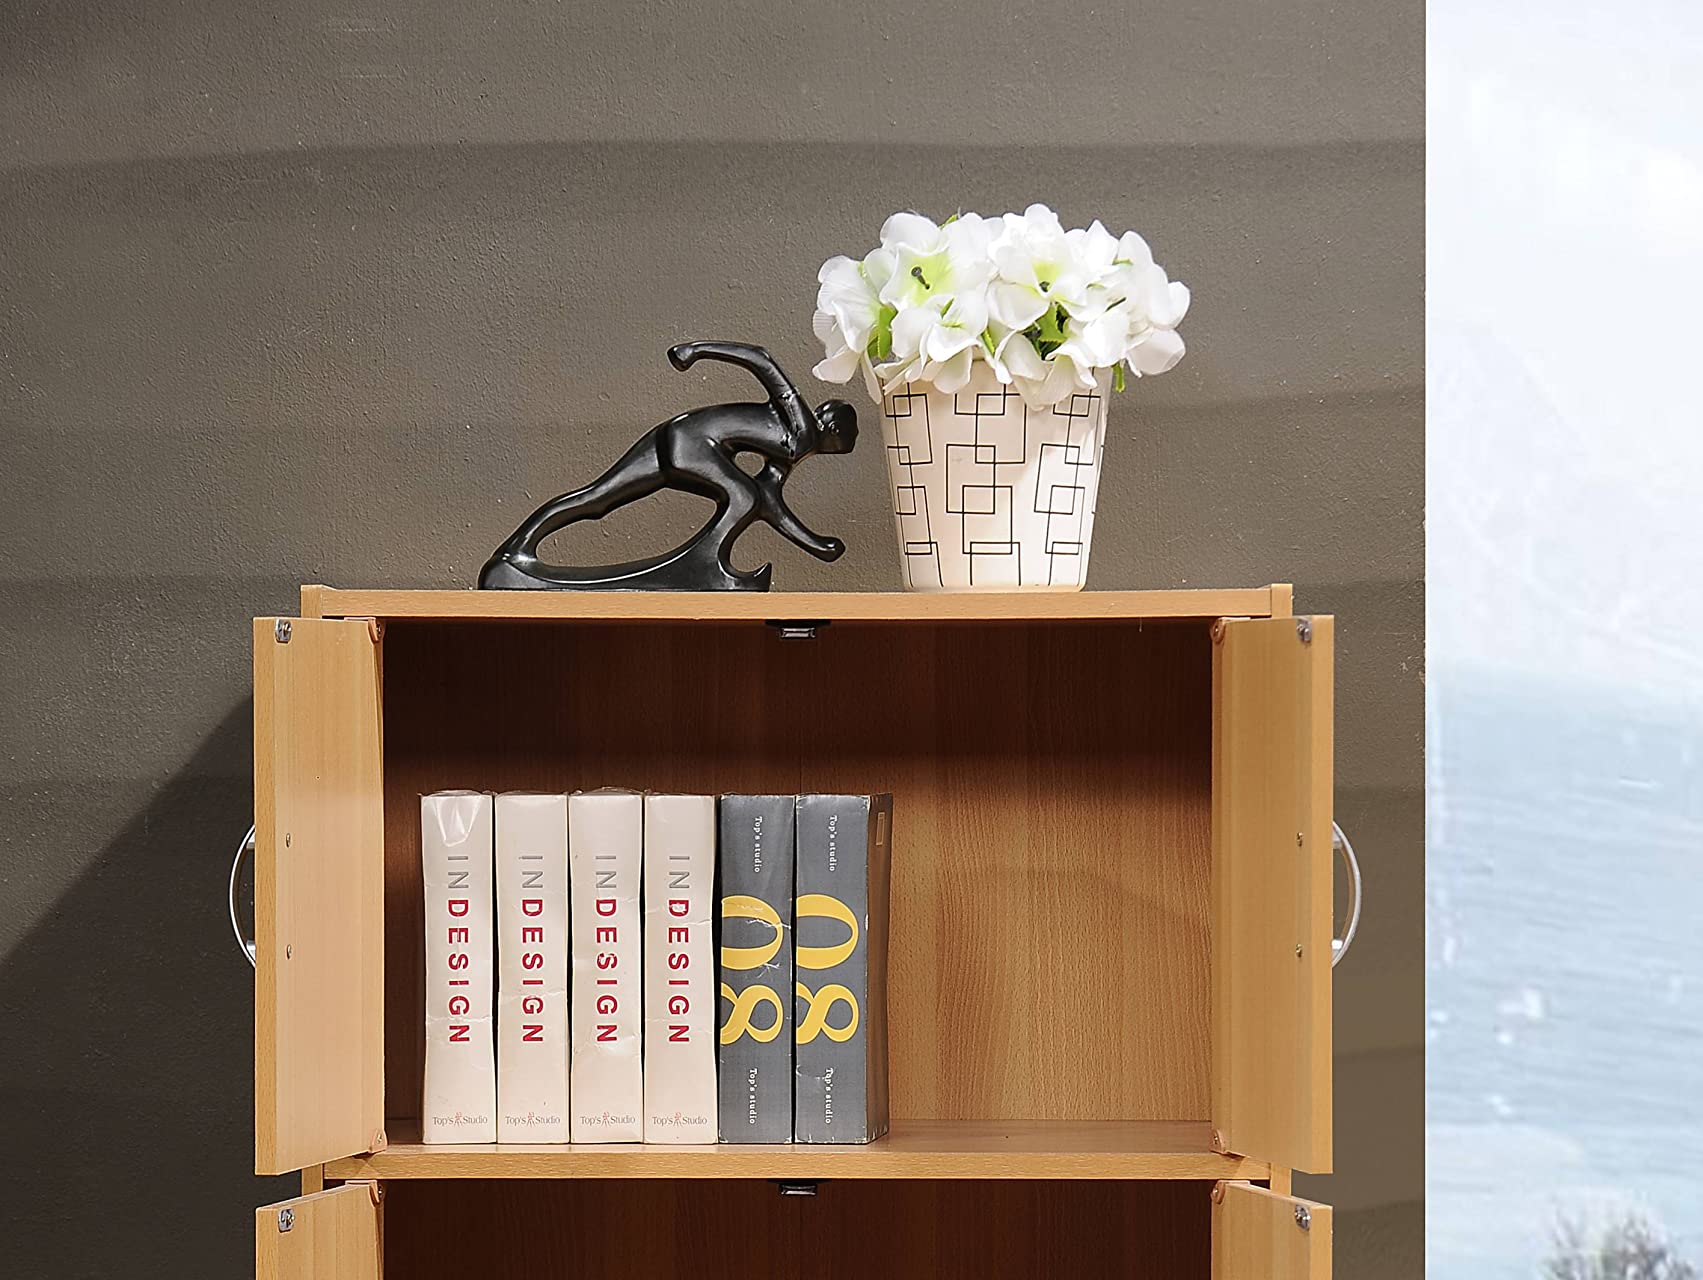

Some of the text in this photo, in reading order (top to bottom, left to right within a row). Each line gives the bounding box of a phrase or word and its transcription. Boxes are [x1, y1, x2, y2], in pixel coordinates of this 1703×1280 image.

[753, 816, 763, 873] Top's studio
[828, 814, 838, 872] Top's studio
[447, 855, 471, 1043] INDESIGN
[521, 855, 544, 1042] INDESIGN
[595, 855, 618, 1042] INDESIGN
[668, 855, 691, 1043] INDESIGN
[432, 1115, 488, 1126] Top's Studio
[505, 1115, 561, 1126] Top's Studio
[580, 1115, 636, 1126] Top's Studio
[652, 1115, 708, 1126] Top's Studio
[748, 1068, 758, 1124] Top's studio
[824, 1067, 834, 1124] Top's studio
